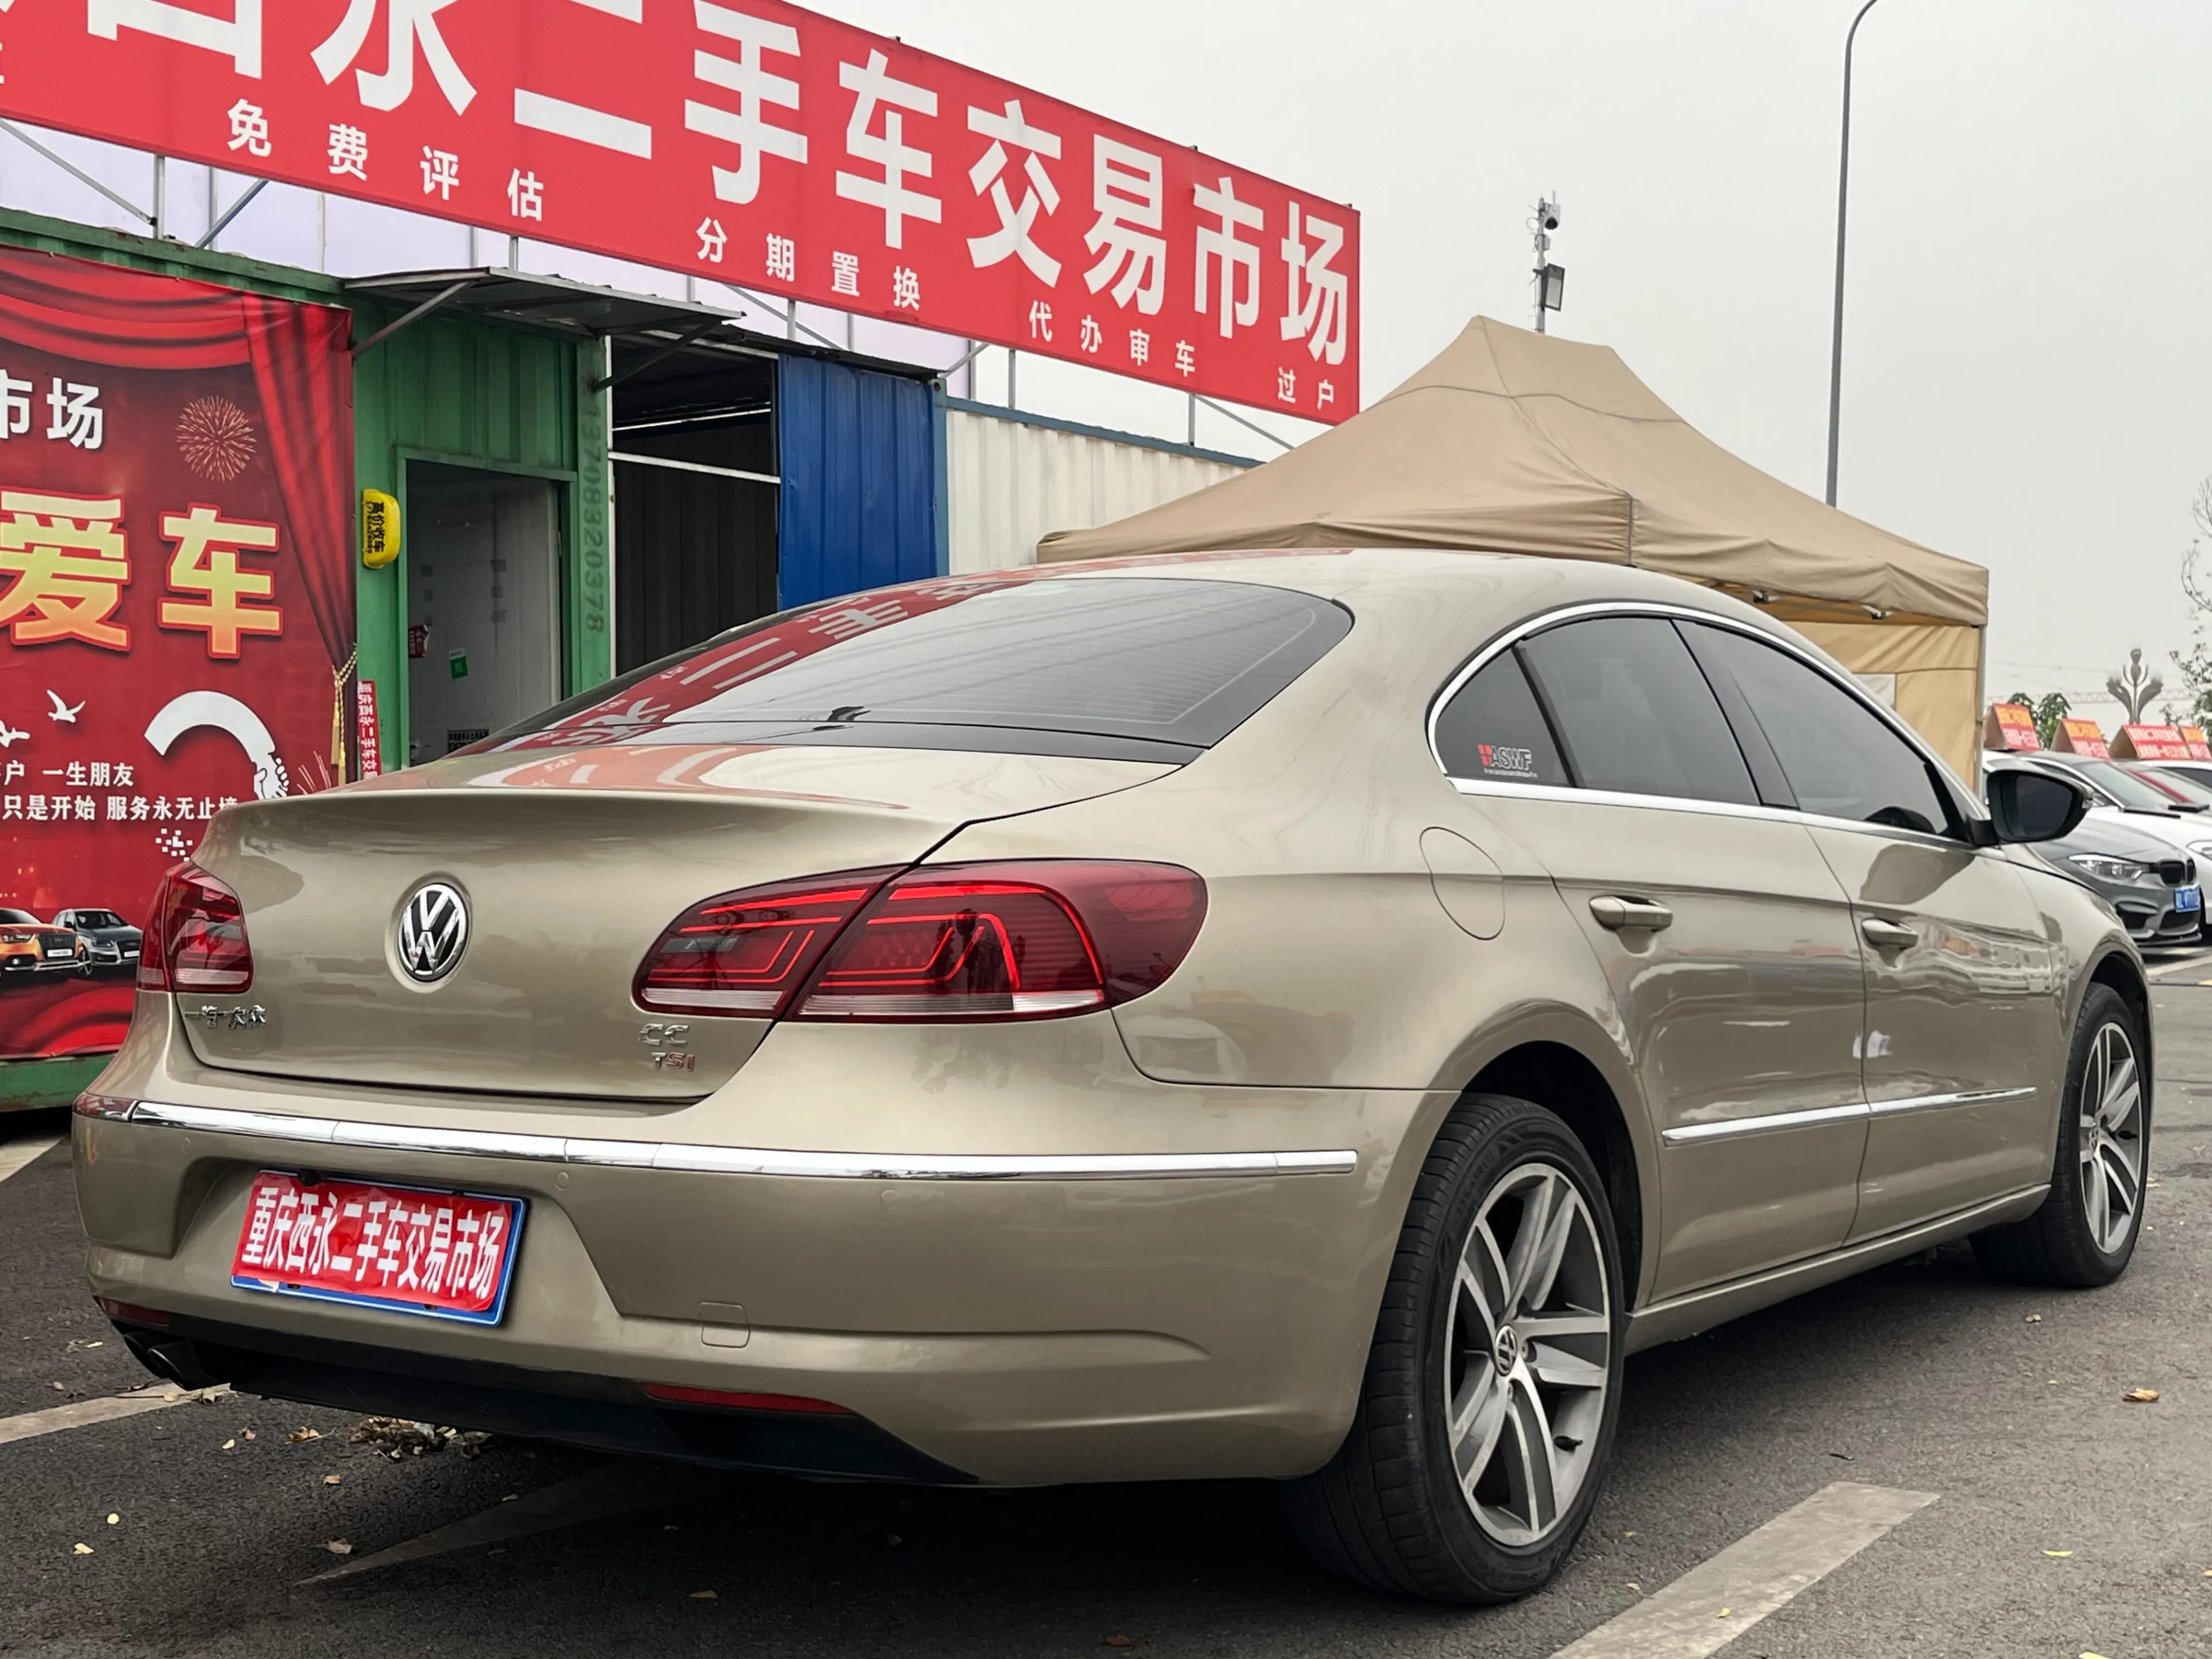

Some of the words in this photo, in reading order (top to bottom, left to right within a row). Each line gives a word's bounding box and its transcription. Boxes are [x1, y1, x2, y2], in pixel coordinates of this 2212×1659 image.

[227, 99, 544, 221] 免费评估
[696, 217, 921, 311] 分期置换
[1029, 300, 1195, 377] 代办审车
[1277, 366, 1334, 410] 过户
[0, 369, 103, 449] 市场
[373, 501, 385, 552] 高价收车
[0, 490, 280, 656] 爱车
[0, 760, 25, 785] 户
[43, 760, 135, 787] 一生朋友
[2, 794, 96, 821] 只是开始
[638, 1022, 690, 1046] CC
[651, 1052, 695, 1072] TSI
[241, 1186, 506, 1300] 重庆西永二手车交易市场
